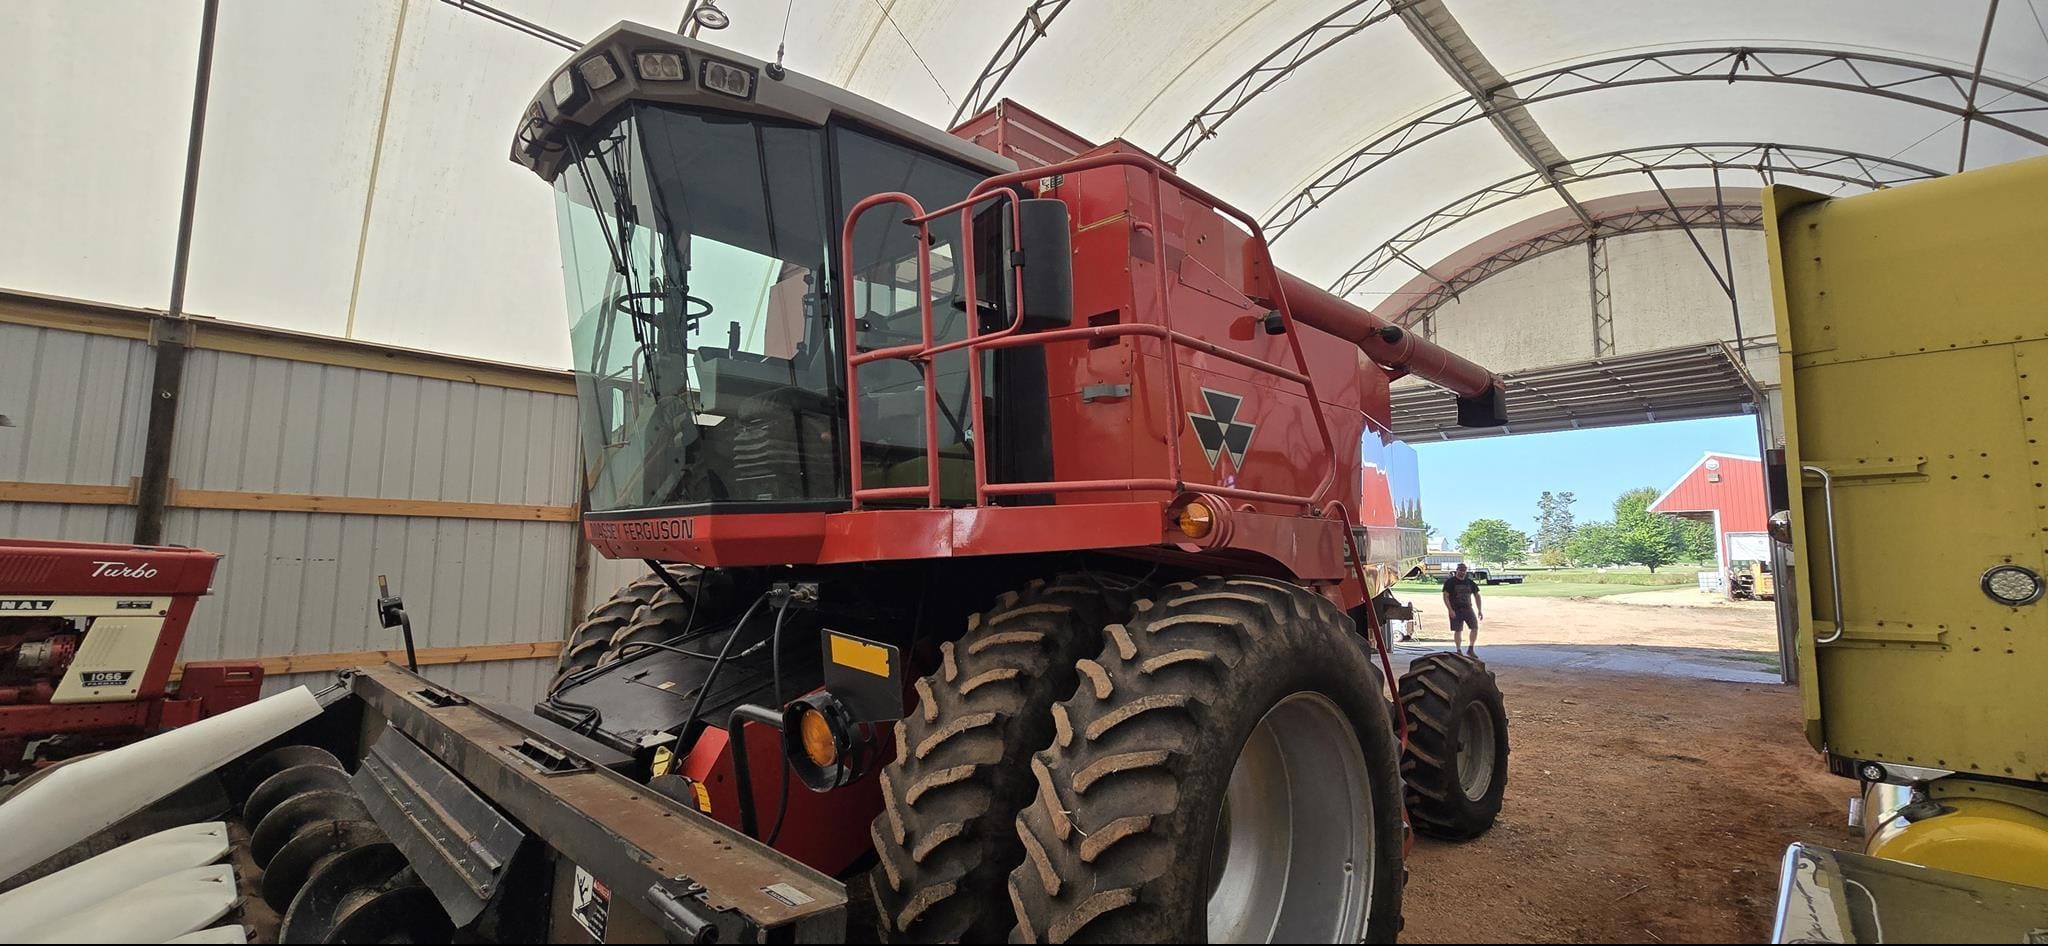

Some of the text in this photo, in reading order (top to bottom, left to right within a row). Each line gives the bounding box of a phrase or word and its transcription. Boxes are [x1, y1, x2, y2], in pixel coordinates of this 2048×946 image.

[623, 519, 693, 540] FERGUSON
[92, 561, 158, 578] Turbo
[0, 601, 48, 610] NAL
[92, 672, 122, 681] 1066
